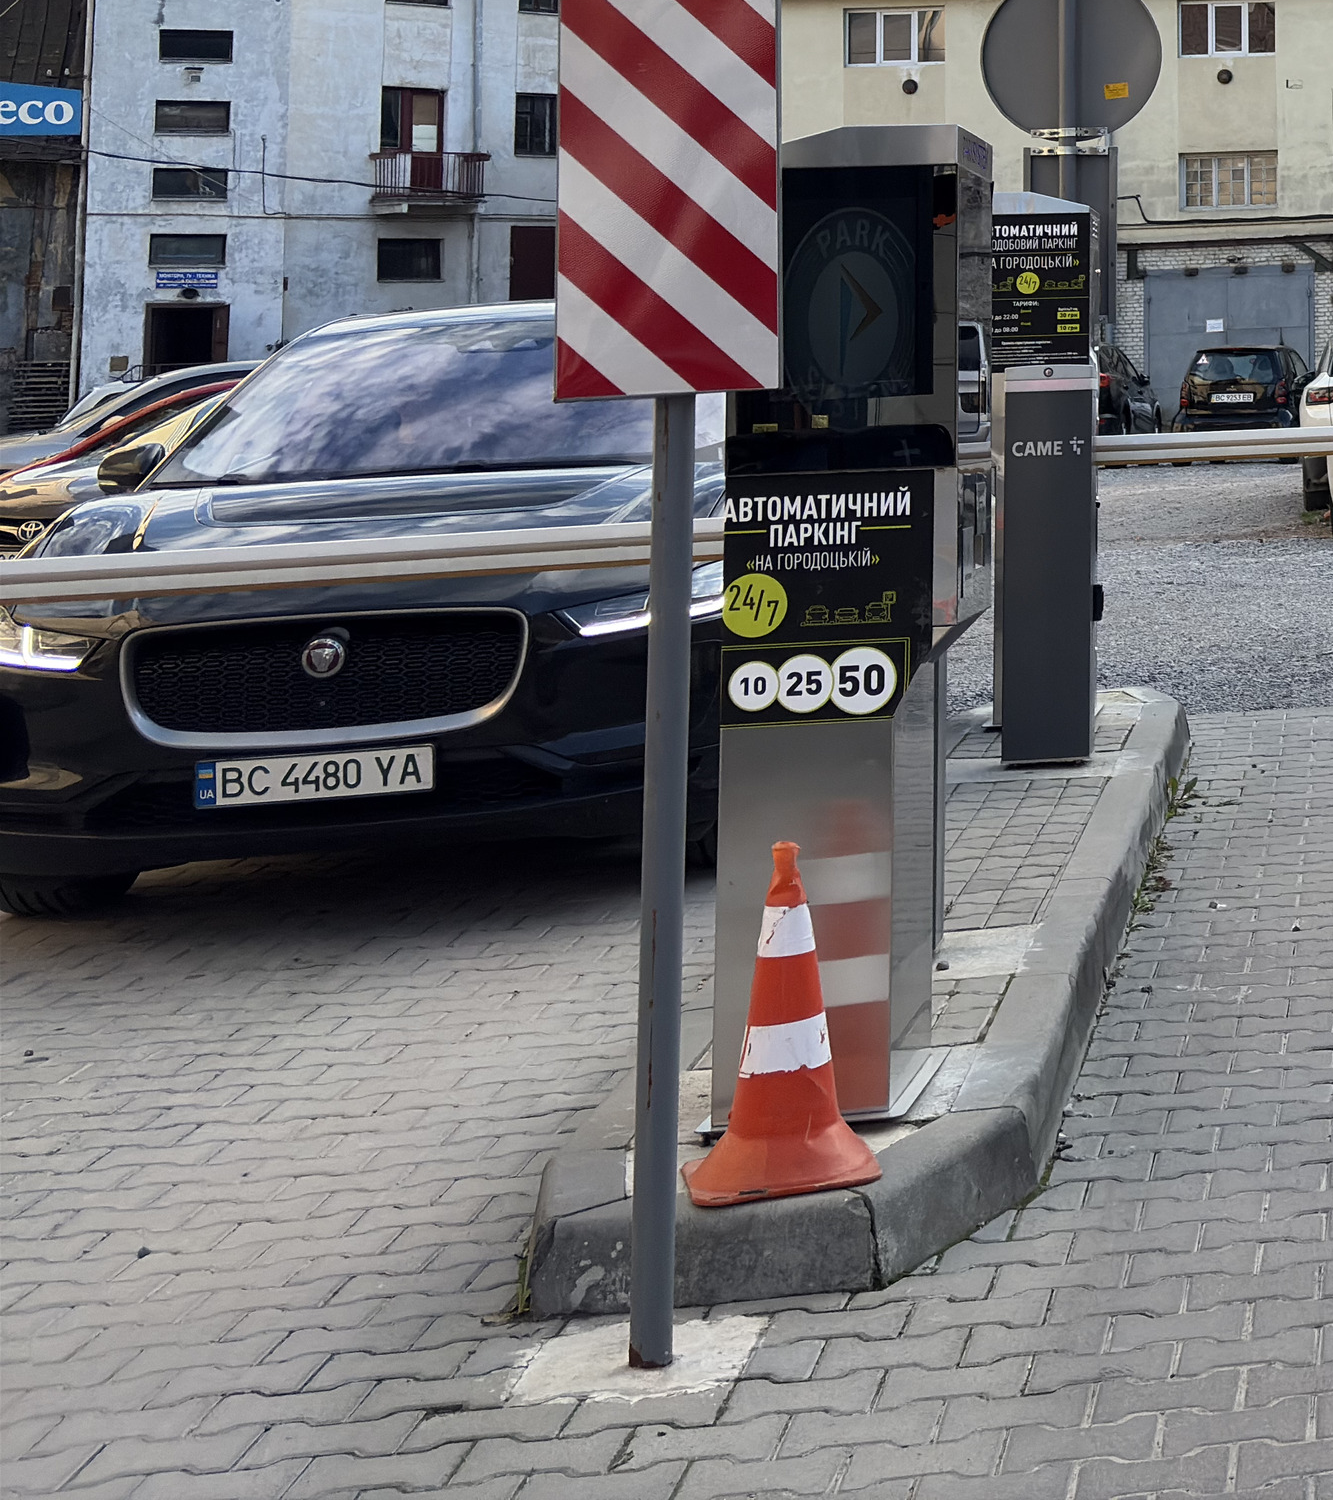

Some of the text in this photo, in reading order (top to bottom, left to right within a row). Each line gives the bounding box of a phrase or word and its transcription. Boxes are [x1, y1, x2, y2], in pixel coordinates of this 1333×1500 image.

[816, 219, 892, 259] PARK
[992, 221, 1078, 237] ТОМАТИЧНИЙ
[992, 237, 1078, 252] ОДОБОВИЙ ПАРКІНГ
[1019, 275, 1037, 290] 24/7
[1012, 441, 1063, 457] CAME
[724, 486, 911, 522] АВТОМАТИЧНИЙ
[769, 521, 862, 547] ПАРКІНГ
[728, 583, 780, 627] 24/7
[739, 663, 885, 698] 10 25 50
[222, 753, 422, 798] BC 4480 YA
[199, 789, 215, 799] UA
